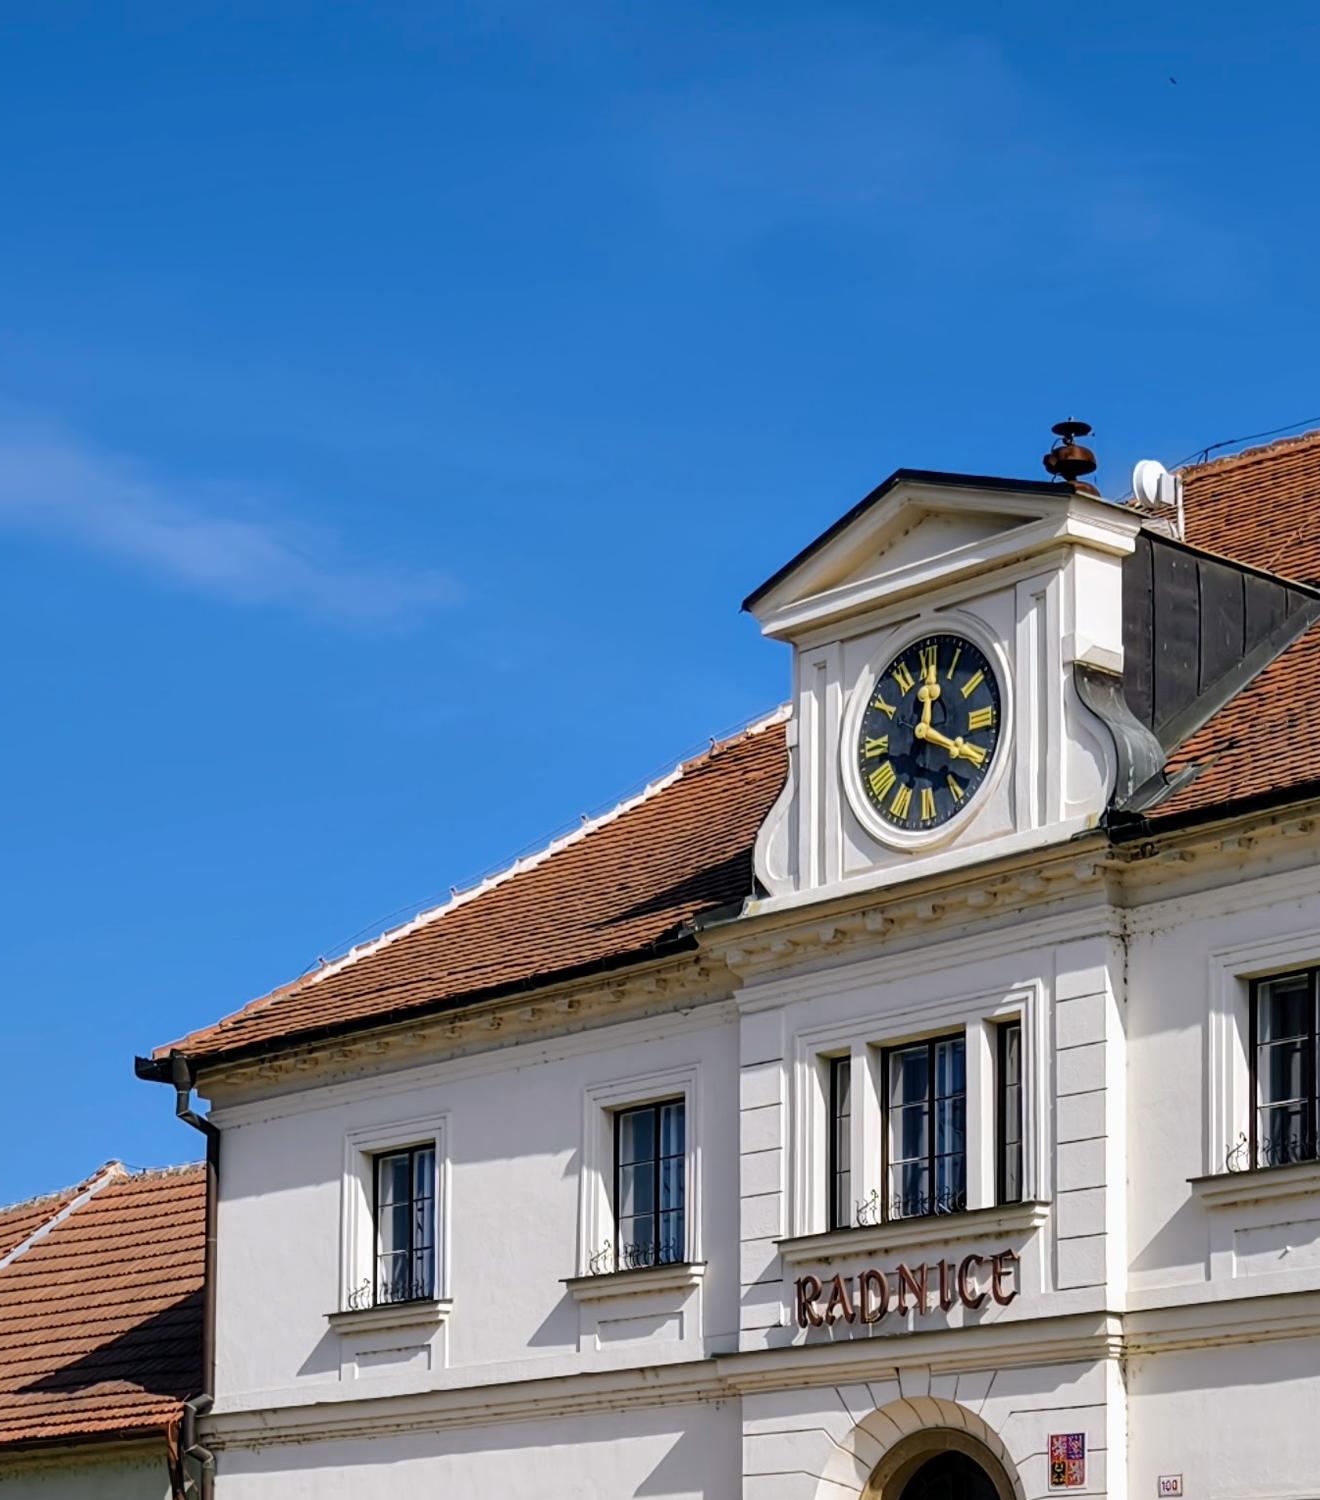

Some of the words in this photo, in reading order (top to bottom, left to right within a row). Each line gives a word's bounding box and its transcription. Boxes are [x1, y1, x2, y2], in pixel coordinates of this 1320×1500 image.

[892, 661, 915, 697] XI
[961, 669, 985, 698] II
[874, 695, 897, 720] X
[968, 706, 992, 731] III
[794, 1248, 1021, 1329] RADNICE
[1161, 1479, 1178, 1492] 100
